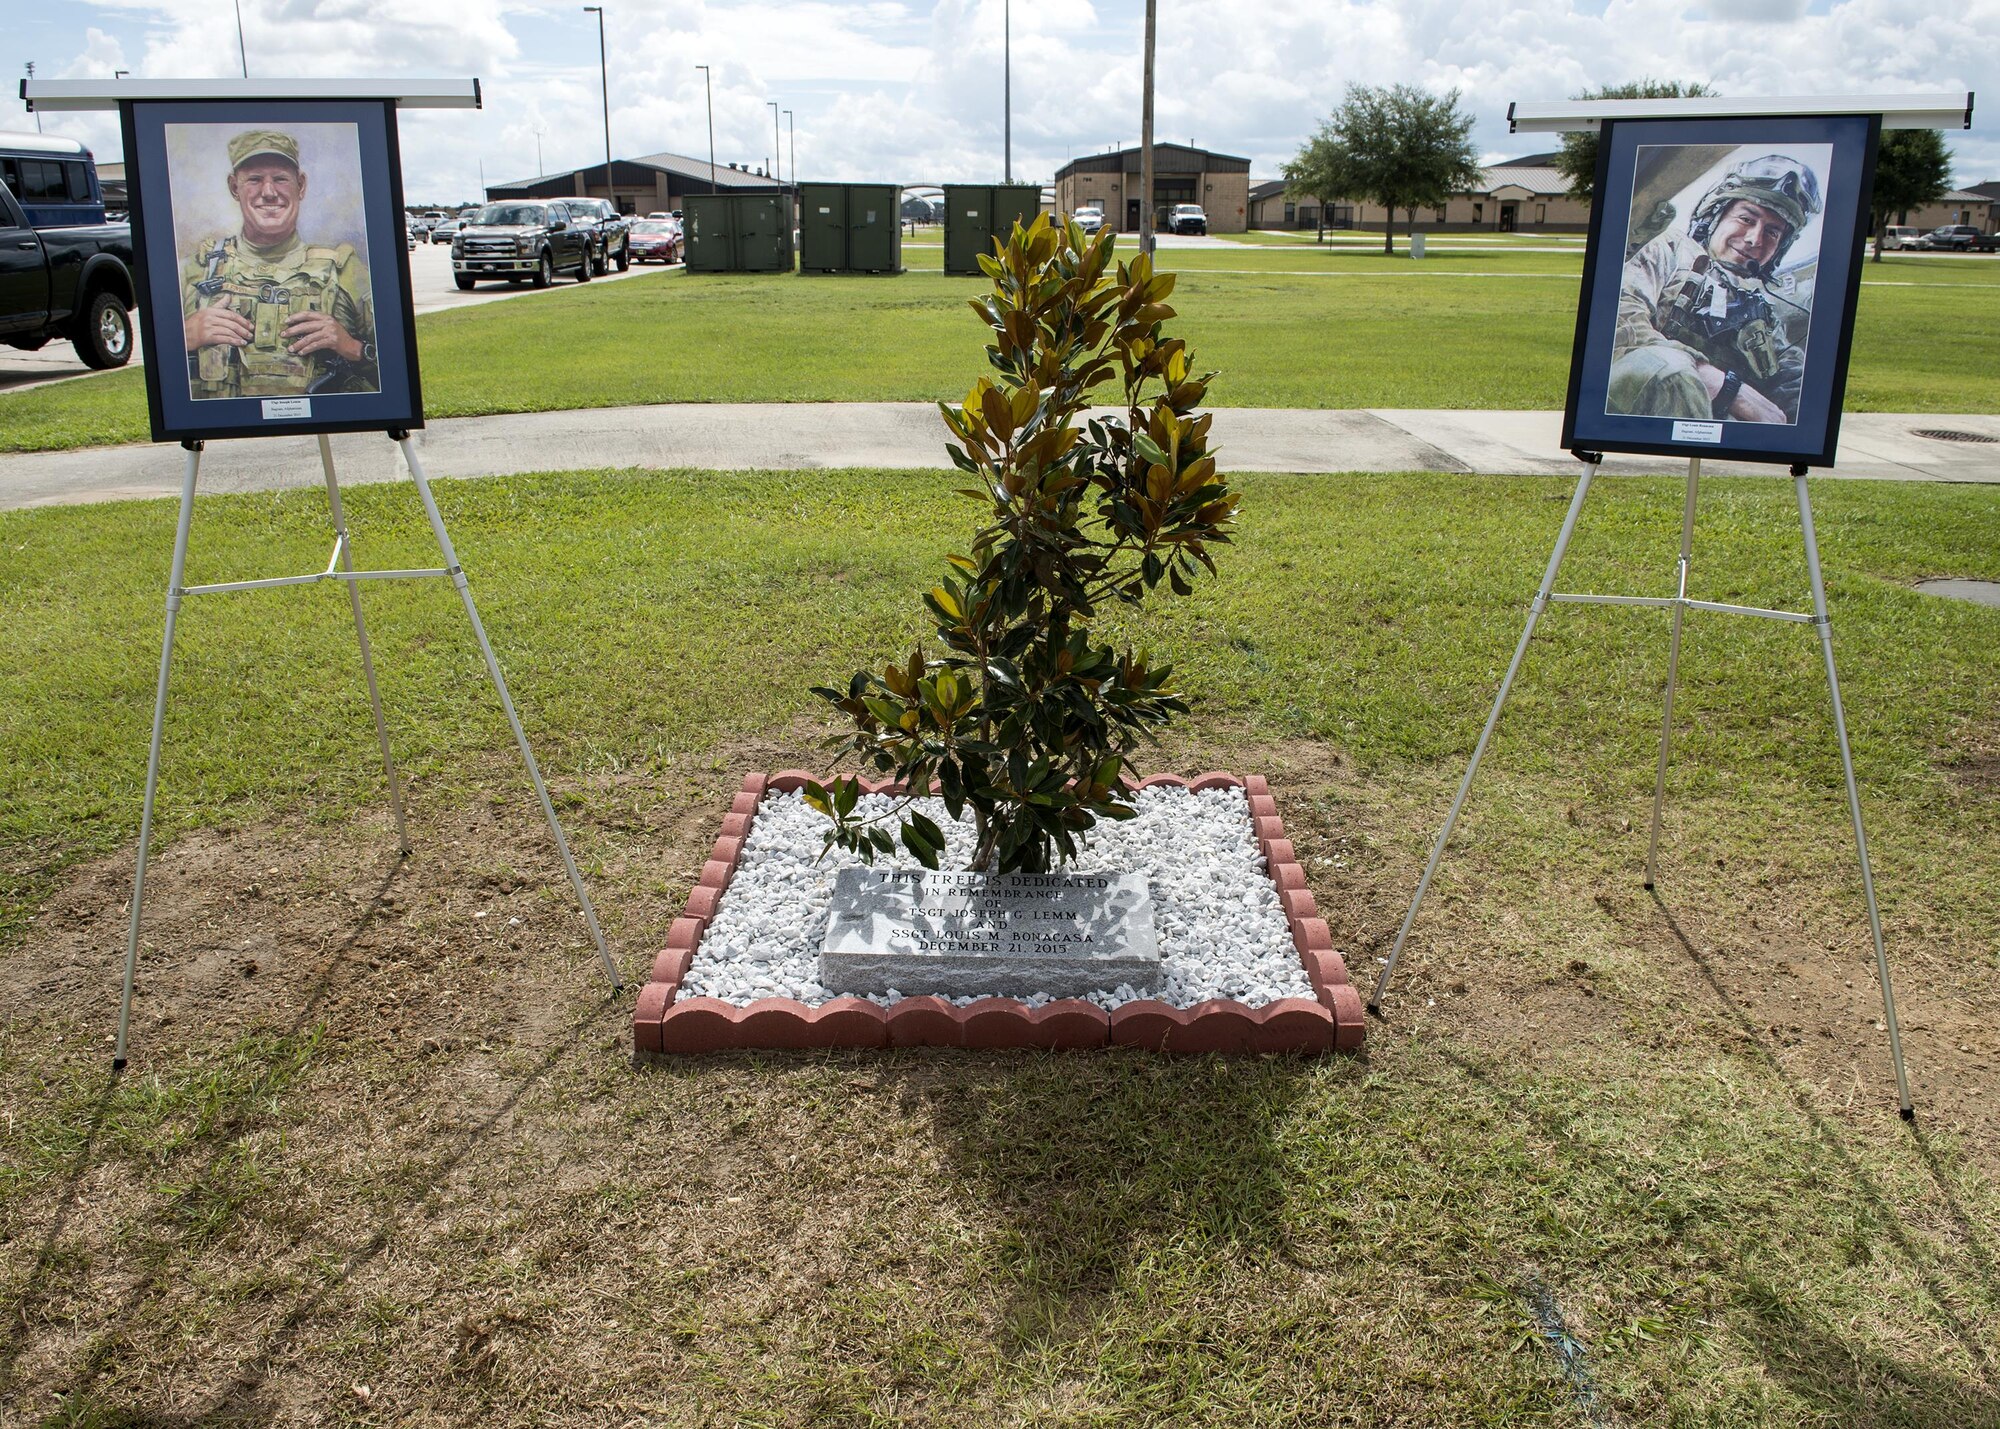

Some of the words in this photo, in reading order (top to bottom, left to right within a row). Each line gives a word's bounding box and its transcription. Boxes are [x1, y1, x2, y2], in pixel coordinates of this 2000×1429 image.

[879, 873, 920, 883] THIS
[930, 874, 976, 885] TREE
[985, 876, 1002, 885] IS
[1011, 876, 1108, 888] DEDICATED
[925, 887, 941, 896] IN
[948, 888, 1063, 899] REMEMBRANCE
[985, 900, 1001, 908] OF
[909, 908, 946, 917] TSGT
[952, 909, 1006, 919] JOSEPH
[1034, 911, 1077, 920] LEMM
[975, 920, 1008, 929] AND
[891, 929, 929, 939] SSGT
[936, 930, 980, 940] LOUIS
[1013, 932, 1094, 943] BONACASA
[919, 941, 1000, 952] DECEMBER
[1034, 943, 1067, 954] 2015
